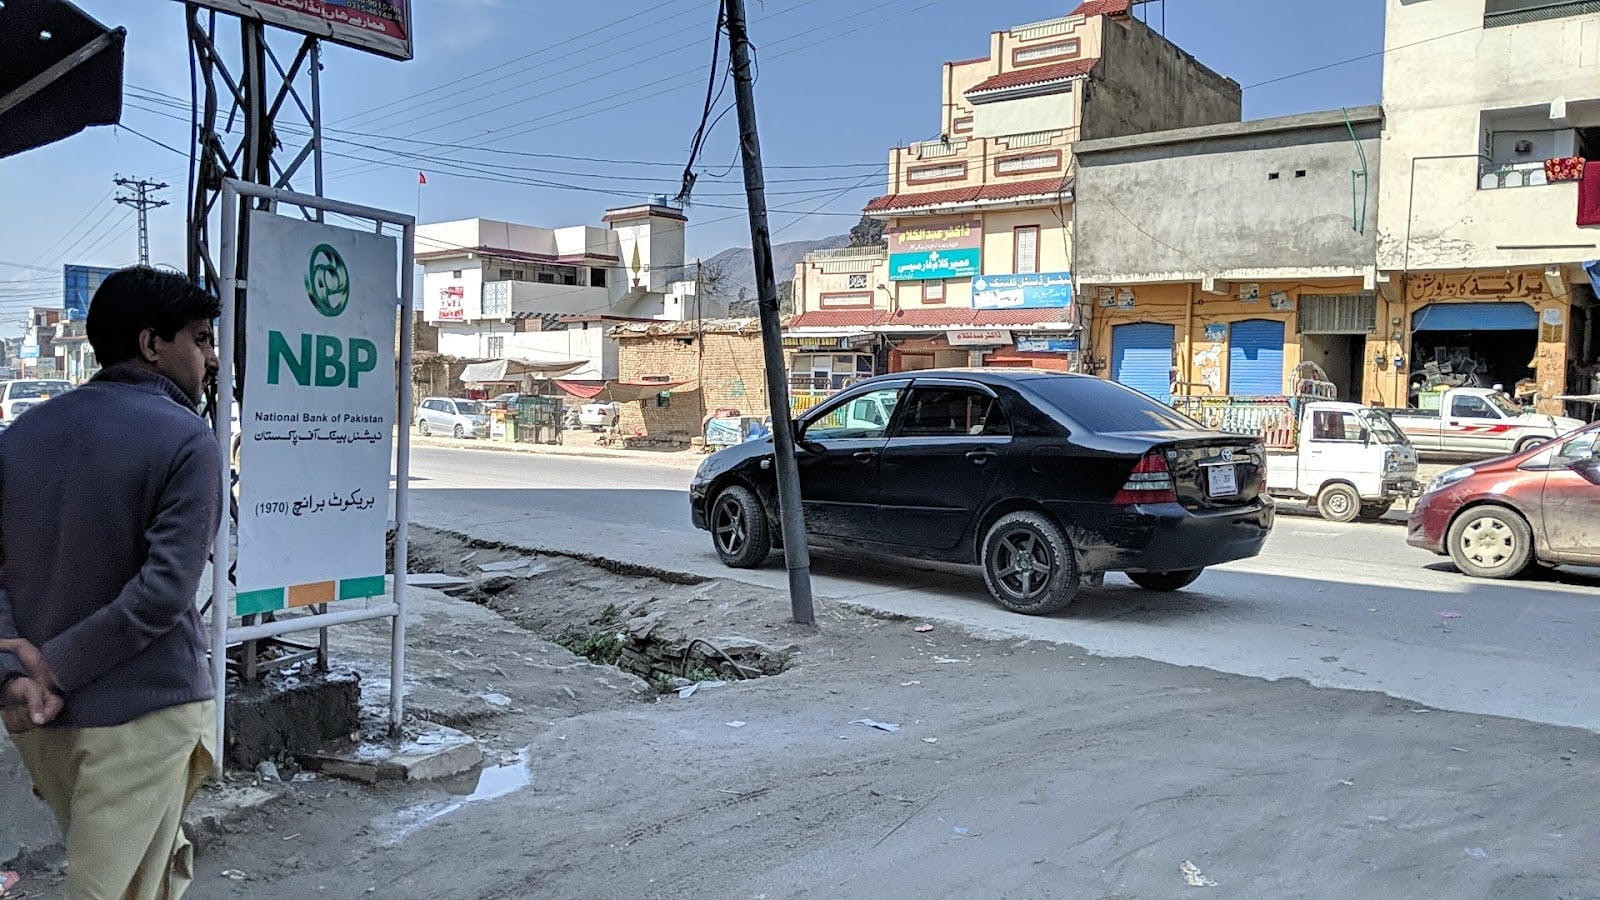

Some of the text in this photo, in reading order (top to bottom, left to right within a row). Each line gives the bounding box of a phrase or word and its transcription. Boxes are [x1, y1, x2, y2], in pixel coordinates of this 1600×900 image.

[898, 222, 971, 245] ڈاکٹر عبدالکلام
[267, 330, 377, 388] NBP
[255, 411, 384, 424] National Bank of Pakistan
[254, 428, 383, 446] نیشنل بینک آف پاکستان
[255, 488, 375, 517] بریکوٹ برانچ (1970)
